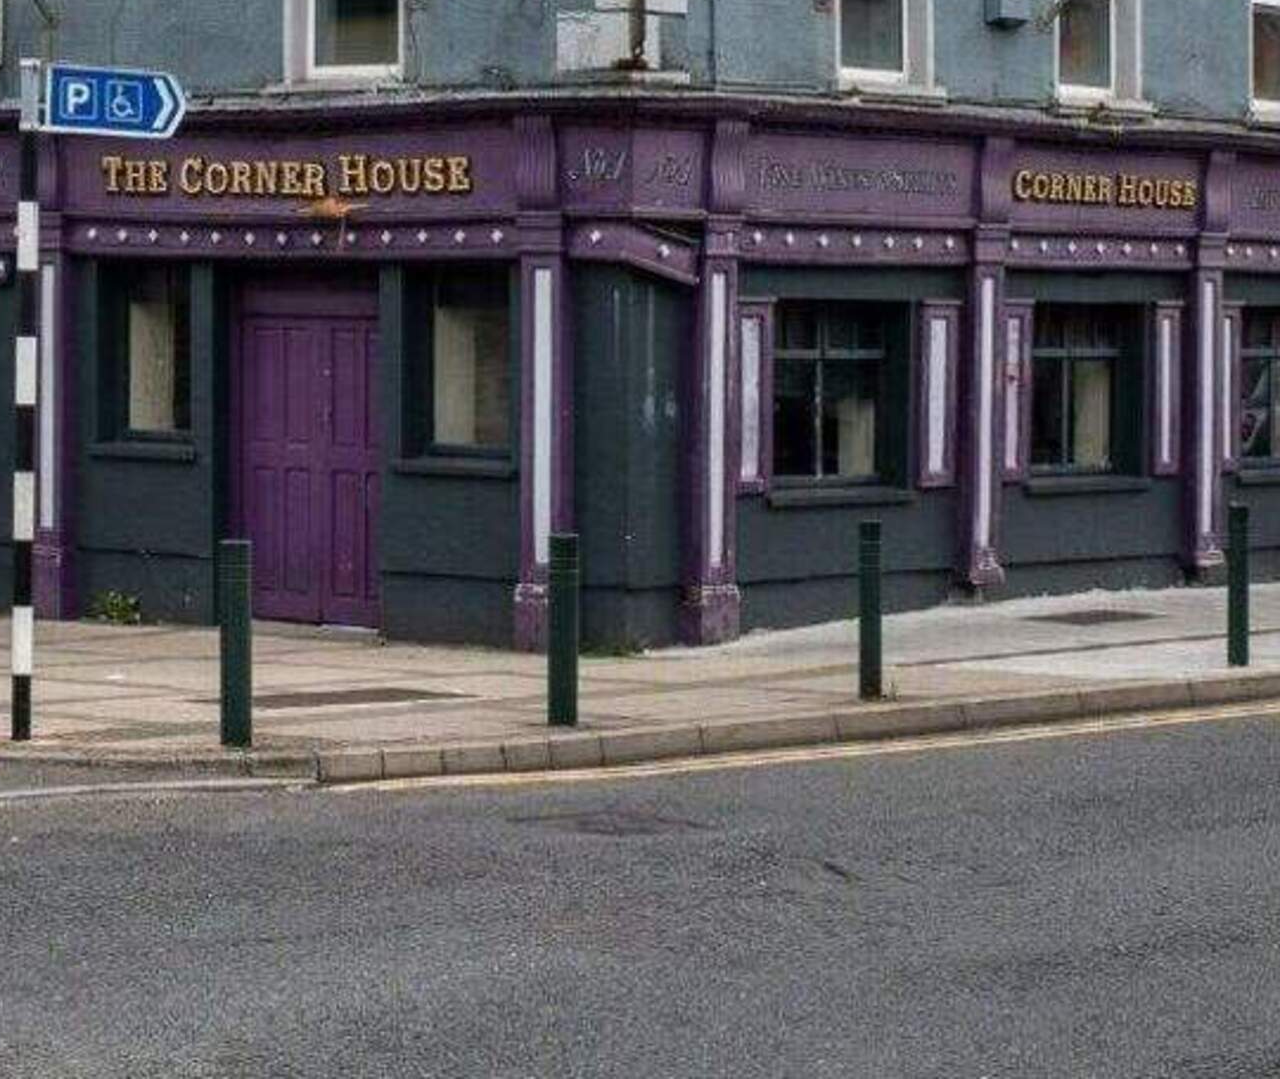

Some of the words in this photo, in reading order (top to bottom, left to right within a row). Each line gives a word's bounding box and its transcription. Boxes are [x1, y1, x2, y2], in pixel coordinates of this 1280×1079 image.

[67, 82, 91, 115] P
[101, 156, 168, 193] THE
[178, 154, 327, 196] CORNER
[338, 155, 473, 194] HOUSE
[1015, 170, 1112, 203] CORNER
[1119, 174, 1197, 207] HOUSE
